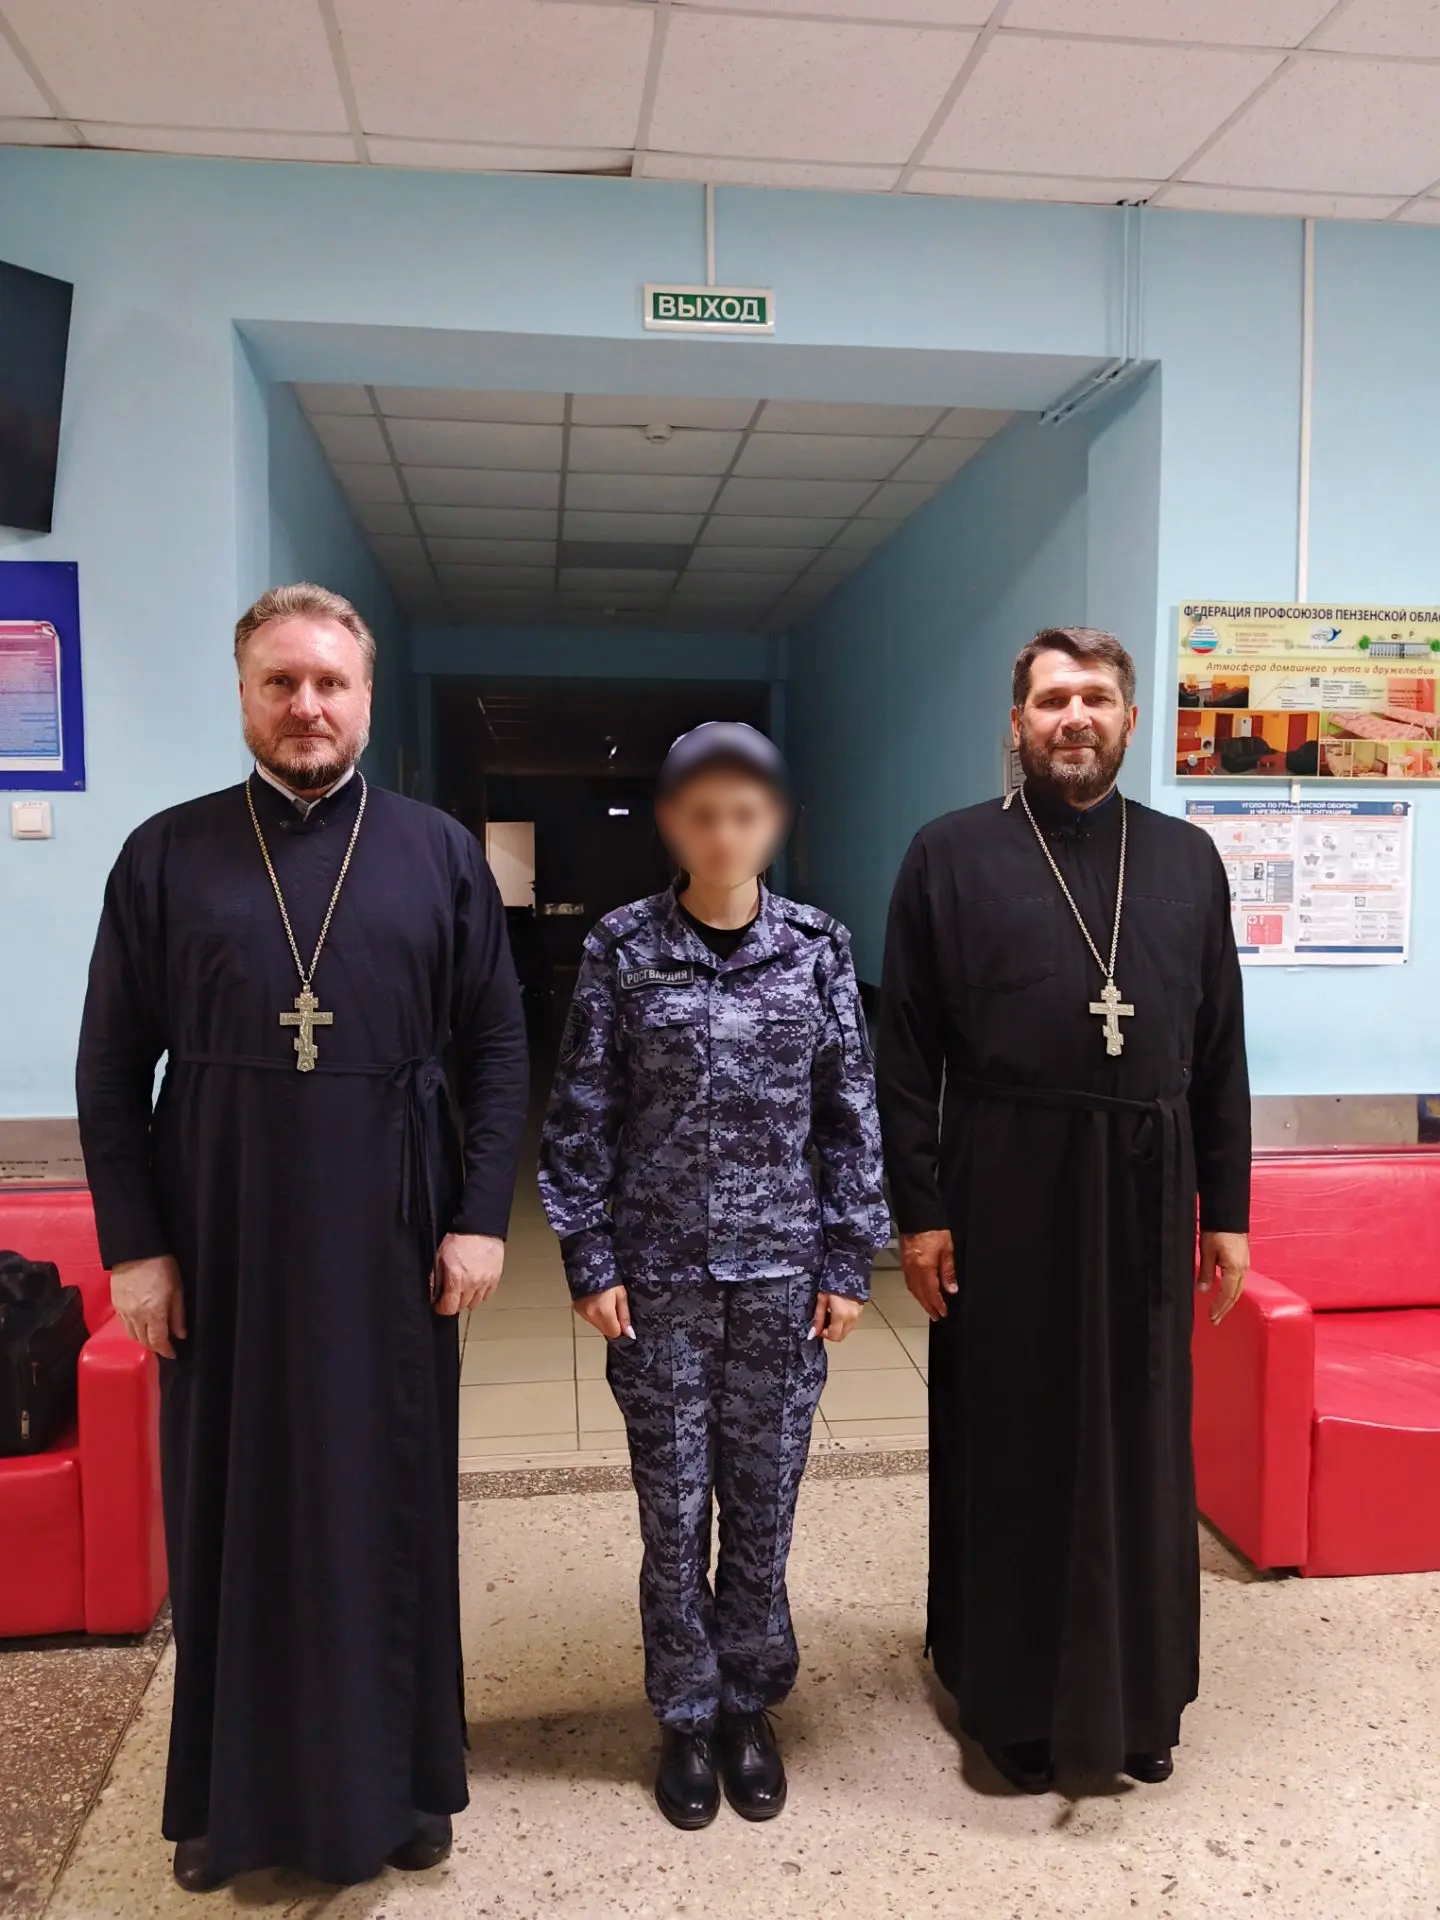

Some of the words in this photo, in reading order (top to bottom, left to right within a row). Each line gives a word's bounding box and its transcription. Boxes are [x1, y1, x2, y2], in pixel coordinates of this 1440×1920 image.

[658, 295, 760, 321] ВЫХОД
[1184, 605, 1251, 619] ФЕДЕРАЦИЯ
[1253, 607, 1333, 619] ПРОФСОЮЗОВ
[1335, 608, 1407, 621] ПЕНЗЕНСКОЙ
[1409, 611, 1440, 623] ОБЛА
[1206, 662, 1267, 673] Атмосфера
[1269, 663, 1328, 673] домашнего
[1332, 665, 1361, 676] уюта
[1363, 666, 1370, 674] и
[1372, 664, 1435, 676] дружелюбия
[627, 969, 688, 984] РОСГВАРДИЯ
